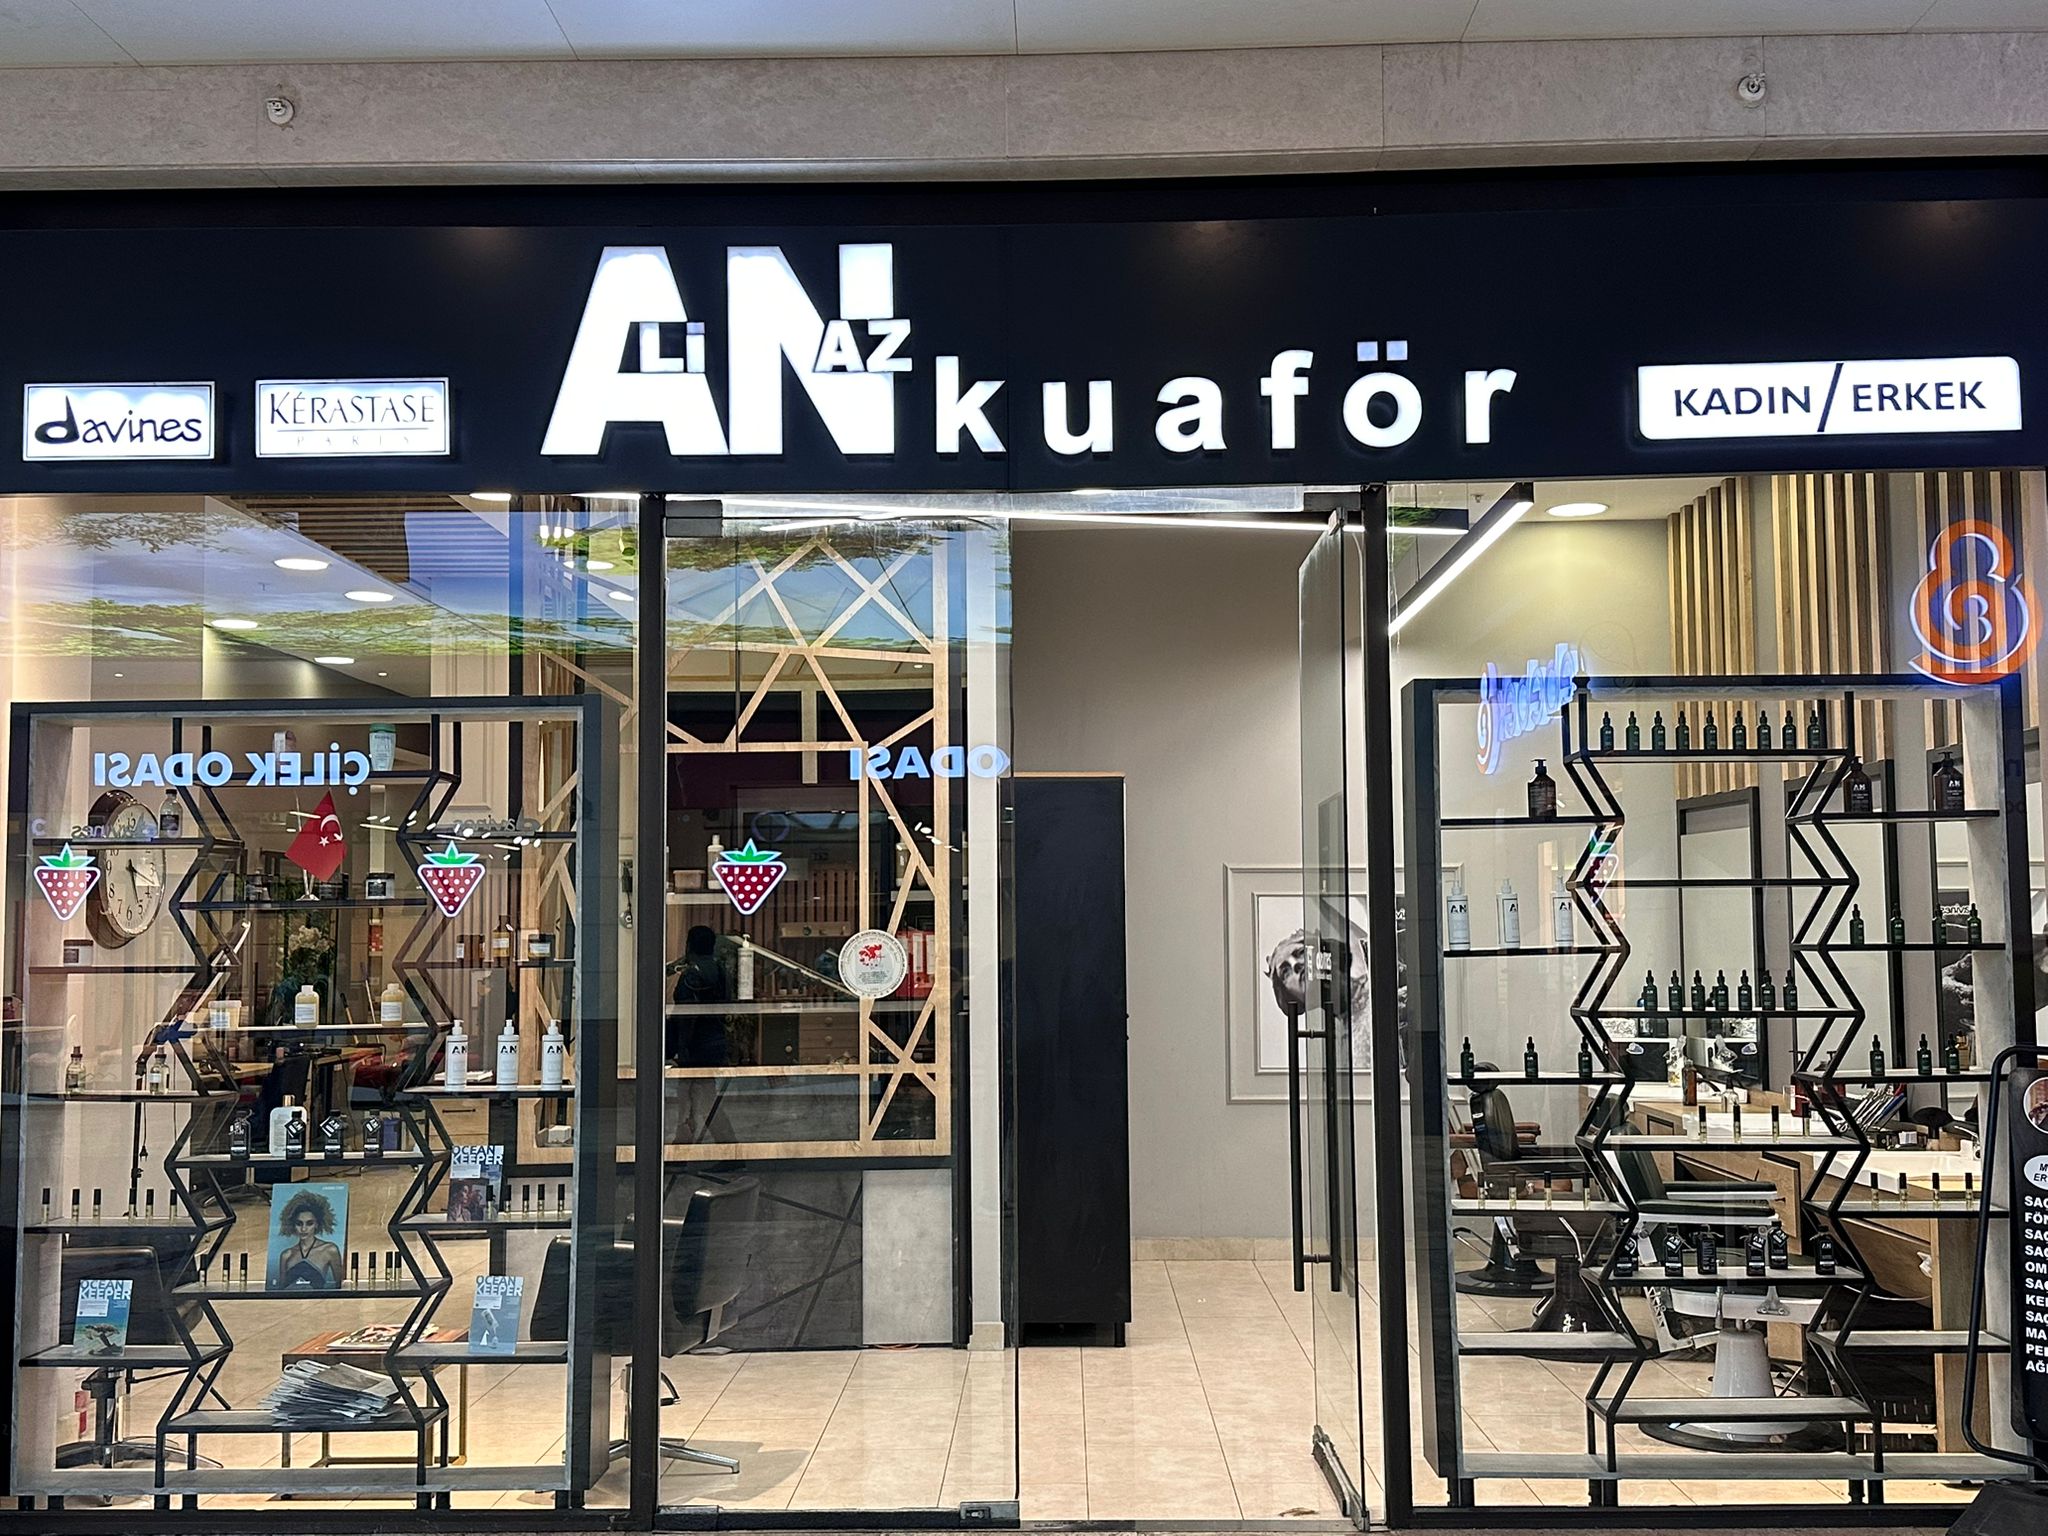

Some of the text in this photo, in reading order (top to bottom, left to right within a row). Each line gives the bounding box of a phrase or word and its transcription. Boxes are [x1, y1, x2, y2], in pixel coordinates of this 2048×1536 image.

[936, 340, 1517, 455] kuaför
[269, 390, 436, 426] KÉRASTASE
[34, 395, 202, 445] davines
[452, 1146, 495, 1155] OCEAN
[453, 1154, 504, 1165] KEEPER
[80, 1280, 124, 1290] OCEAN
[476, 1275, 516, 1286] OCEAN
[80, 1288, 131, 1300] KEEPER
[476, 1284, 523, 1297] KEEPER
[2025, 1359, 2048, 1374] AĞ
